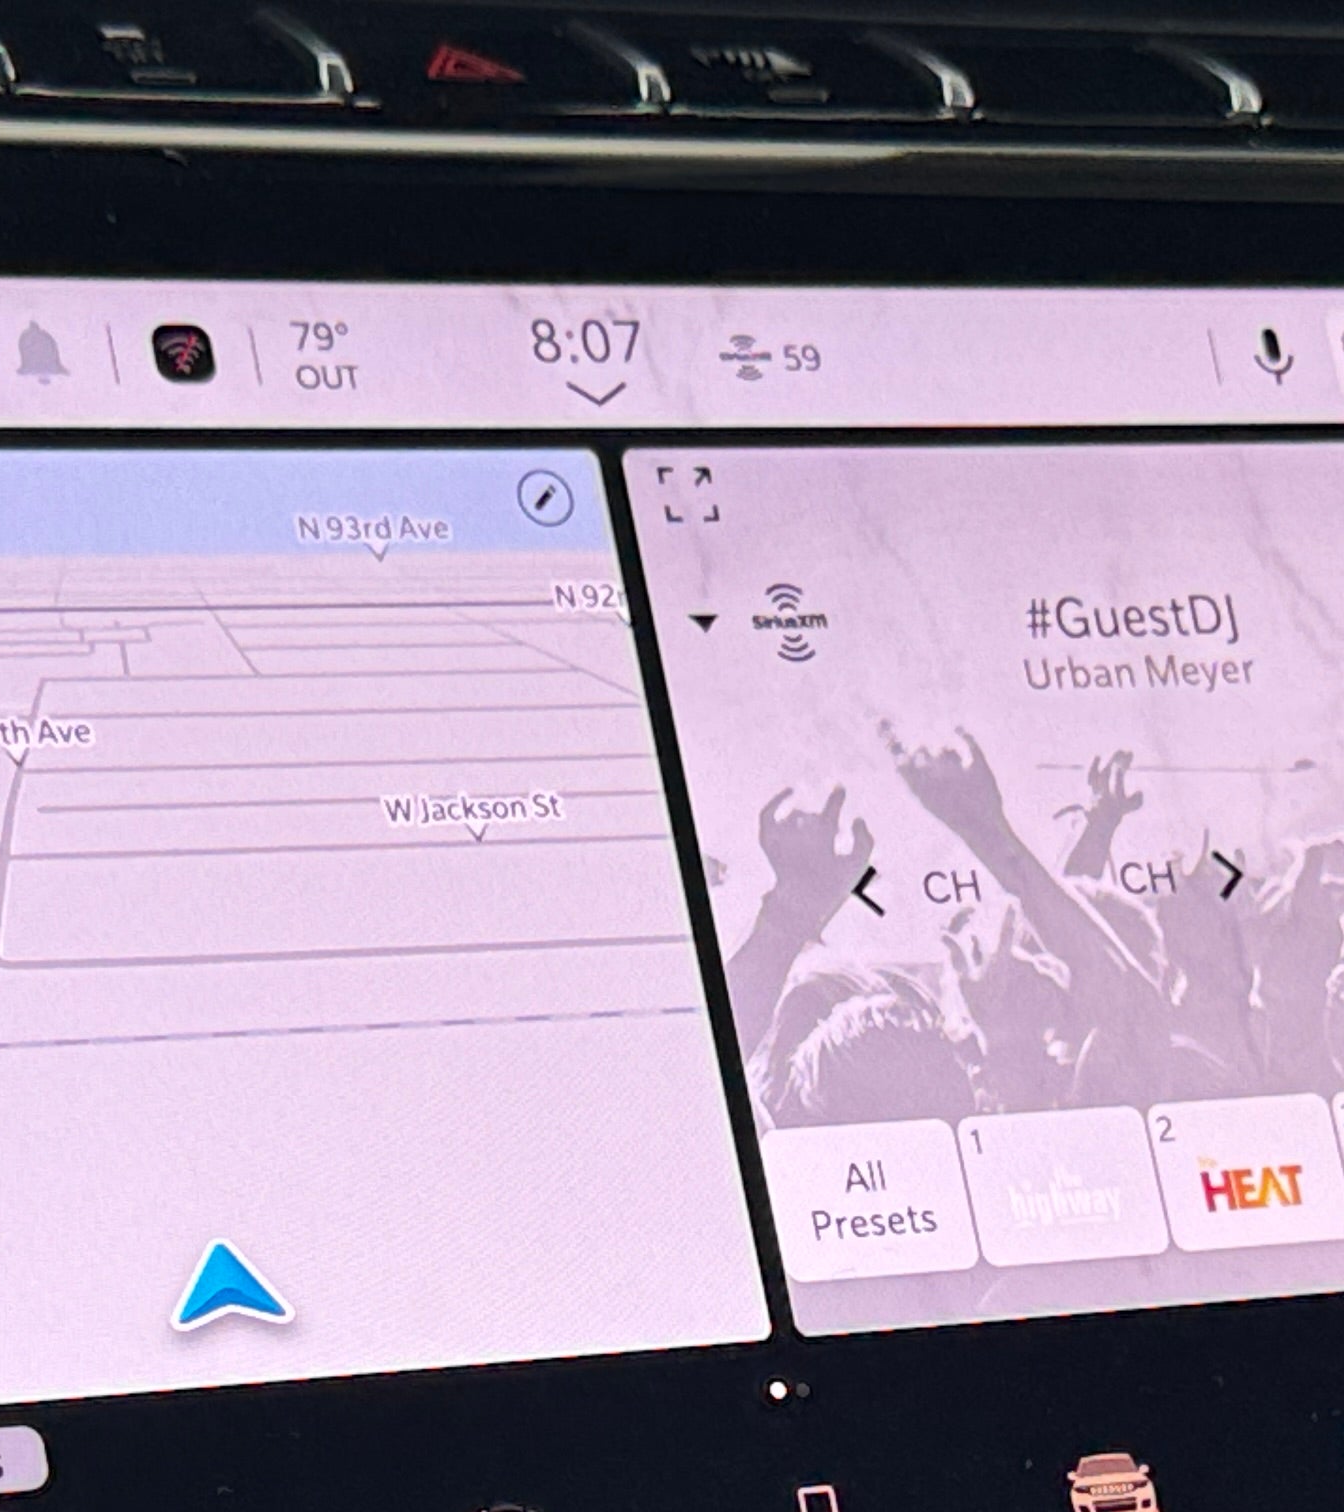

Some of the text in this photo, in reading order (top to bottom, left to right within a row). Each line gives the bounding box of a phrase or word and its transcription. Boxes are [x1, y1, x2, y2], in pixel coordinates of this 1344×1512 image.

[290, 320, 349, 352] 79°
[531, 318, 642, 365] 8:07
[783, 344, 821, 371] 59
[295, 364, 358, 391] OUT
[297, 516, 449, 540] N 93rd Ave
[555, 585, 576, 608] N
[1026, 594, 1240, 644] #GuestDJ
[1023, 656, 1254, 692] Urban Meyer
[37, 721, 91, 744] Ave
[385, 794, 561, 825] W Jackson St
[923, 870, 980, 904] CH
[1119, 861, 1177, 895] CH
[970, 1129, 984, 1155] 1
[1157, 1116, 1176, 1143] 2
[845, 1160, 887, 1194] All
[1200, 1165, 1303, 1213] HEAT
[811, 1205, 938, 1242] Presets
